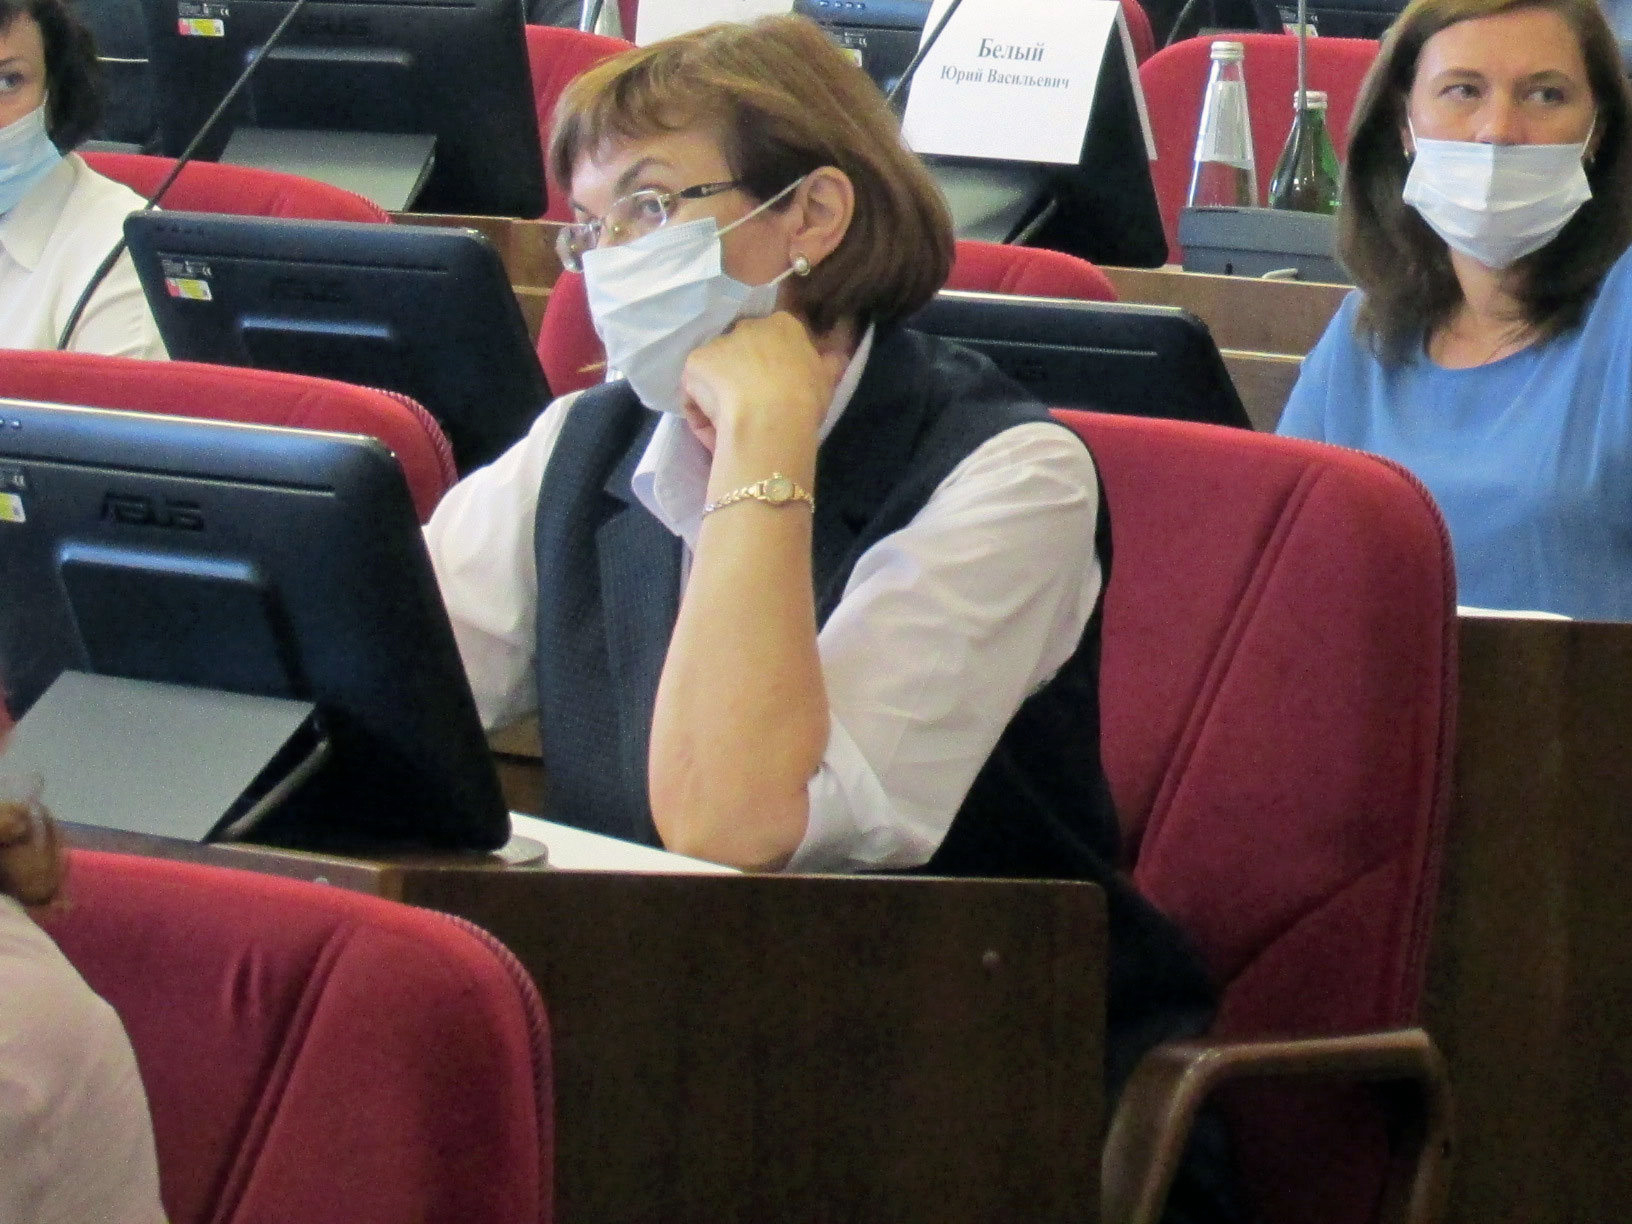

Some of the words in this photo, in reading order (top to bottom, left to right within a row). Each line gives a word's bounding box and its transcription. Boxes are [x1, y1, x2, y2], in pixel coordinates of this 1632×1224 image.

[978, 37, 1045, 62] Белый
[940, 64, 984, 85] Юрий
[987, 68, 1070, 89] Васильевич
